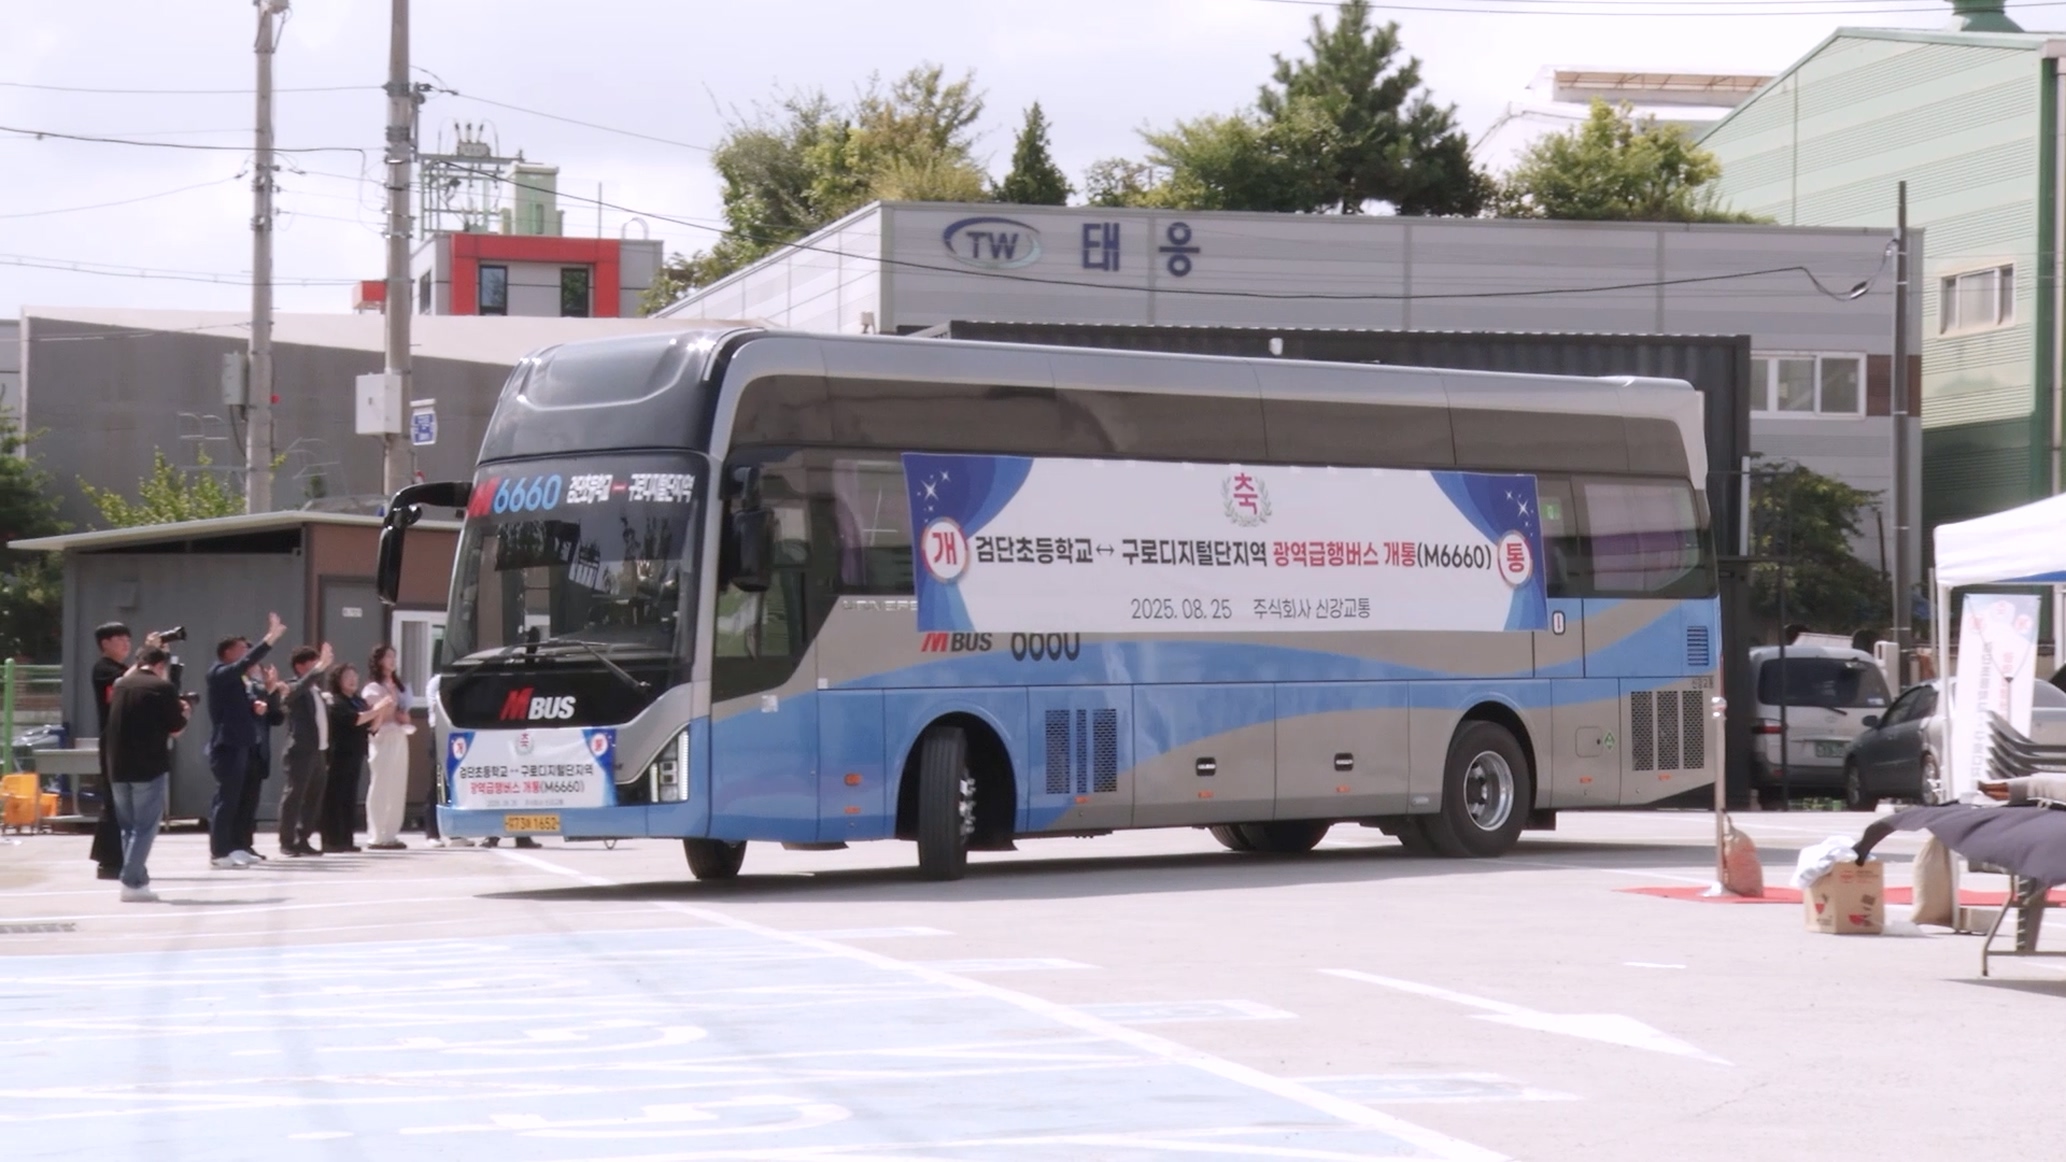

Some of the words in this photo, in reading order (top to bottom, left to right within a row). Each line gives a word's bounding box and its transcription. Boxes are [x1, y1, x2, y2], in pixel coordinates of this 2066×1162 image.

[966, 231, 1018, 260] TW
[1233, 472, 1259, 515] 축
[932, 531, 958, 565] 개
[975, 535, 1094, 565] 검단초등학교
[1121, 538, 1267, 568] 구로디지털단지역
[1272, 540, 1379, 569] 광역급행버스
[1384, 541, 1492, 571] 개통(M6660)
[1505, 542, 1526, 573] 통
[1252, 598, 1312, 621] 주식회사
[1315, 597, 1372, 621] 신강교통
[460, 765, 508, 779] 검단초등학교
[520, 763, 594, 777] 구로디지털단지역
